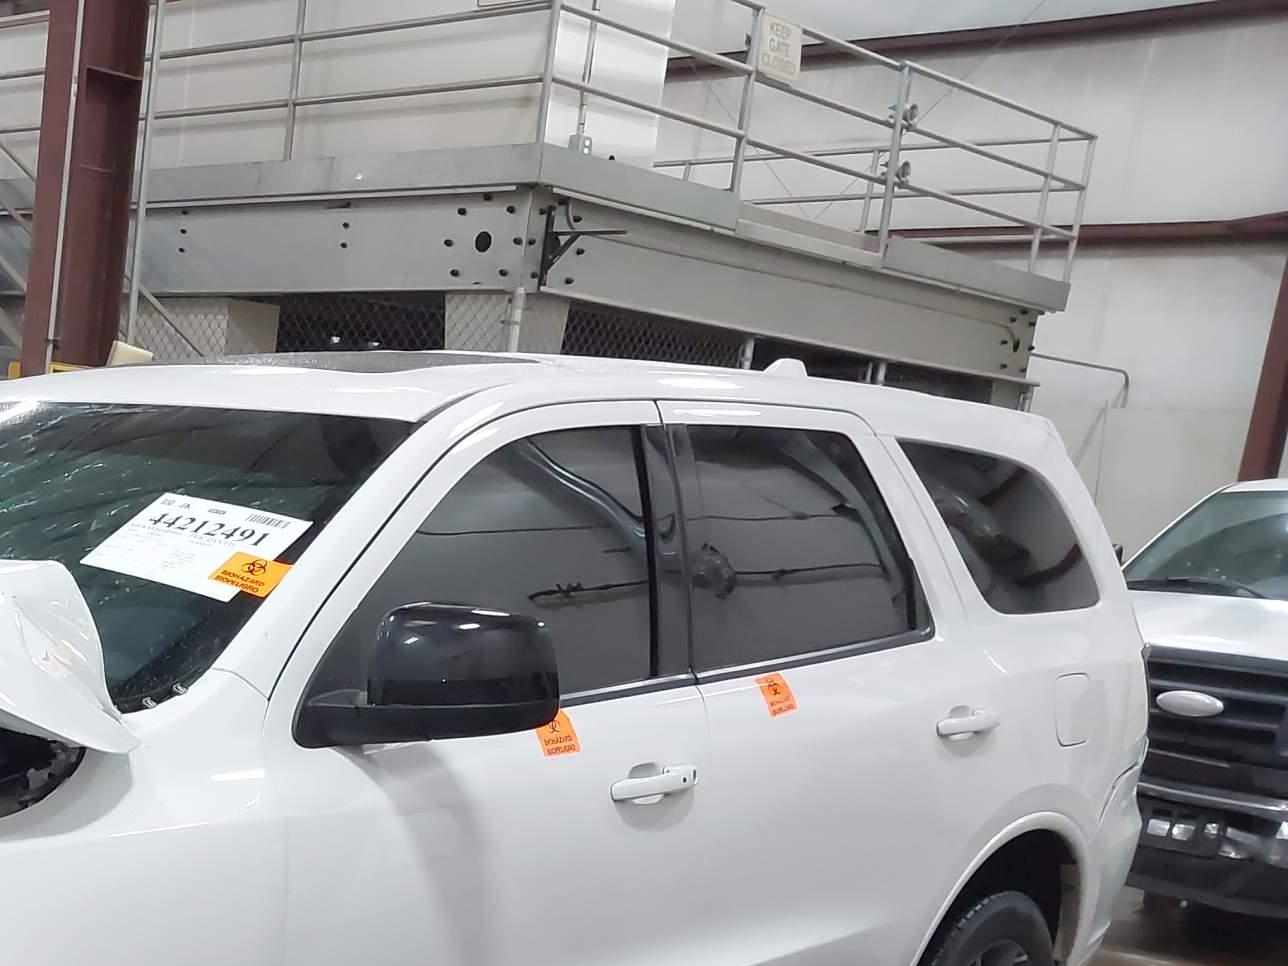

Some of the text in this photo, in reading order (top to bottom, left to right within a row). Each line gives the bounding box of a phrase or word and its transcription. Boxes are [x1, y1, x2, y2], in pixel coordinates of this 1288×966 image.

[769, 23, 791, 39] KEEP
[769, 38, 791, 57] GATE
[762, 52, 795, 76] CLOSED
[149, 513, 269, 546] 44212491
[214, 574, 259, 593] BIOPELIGRO
[221, 569, 265, 587] BIOHAZARD
